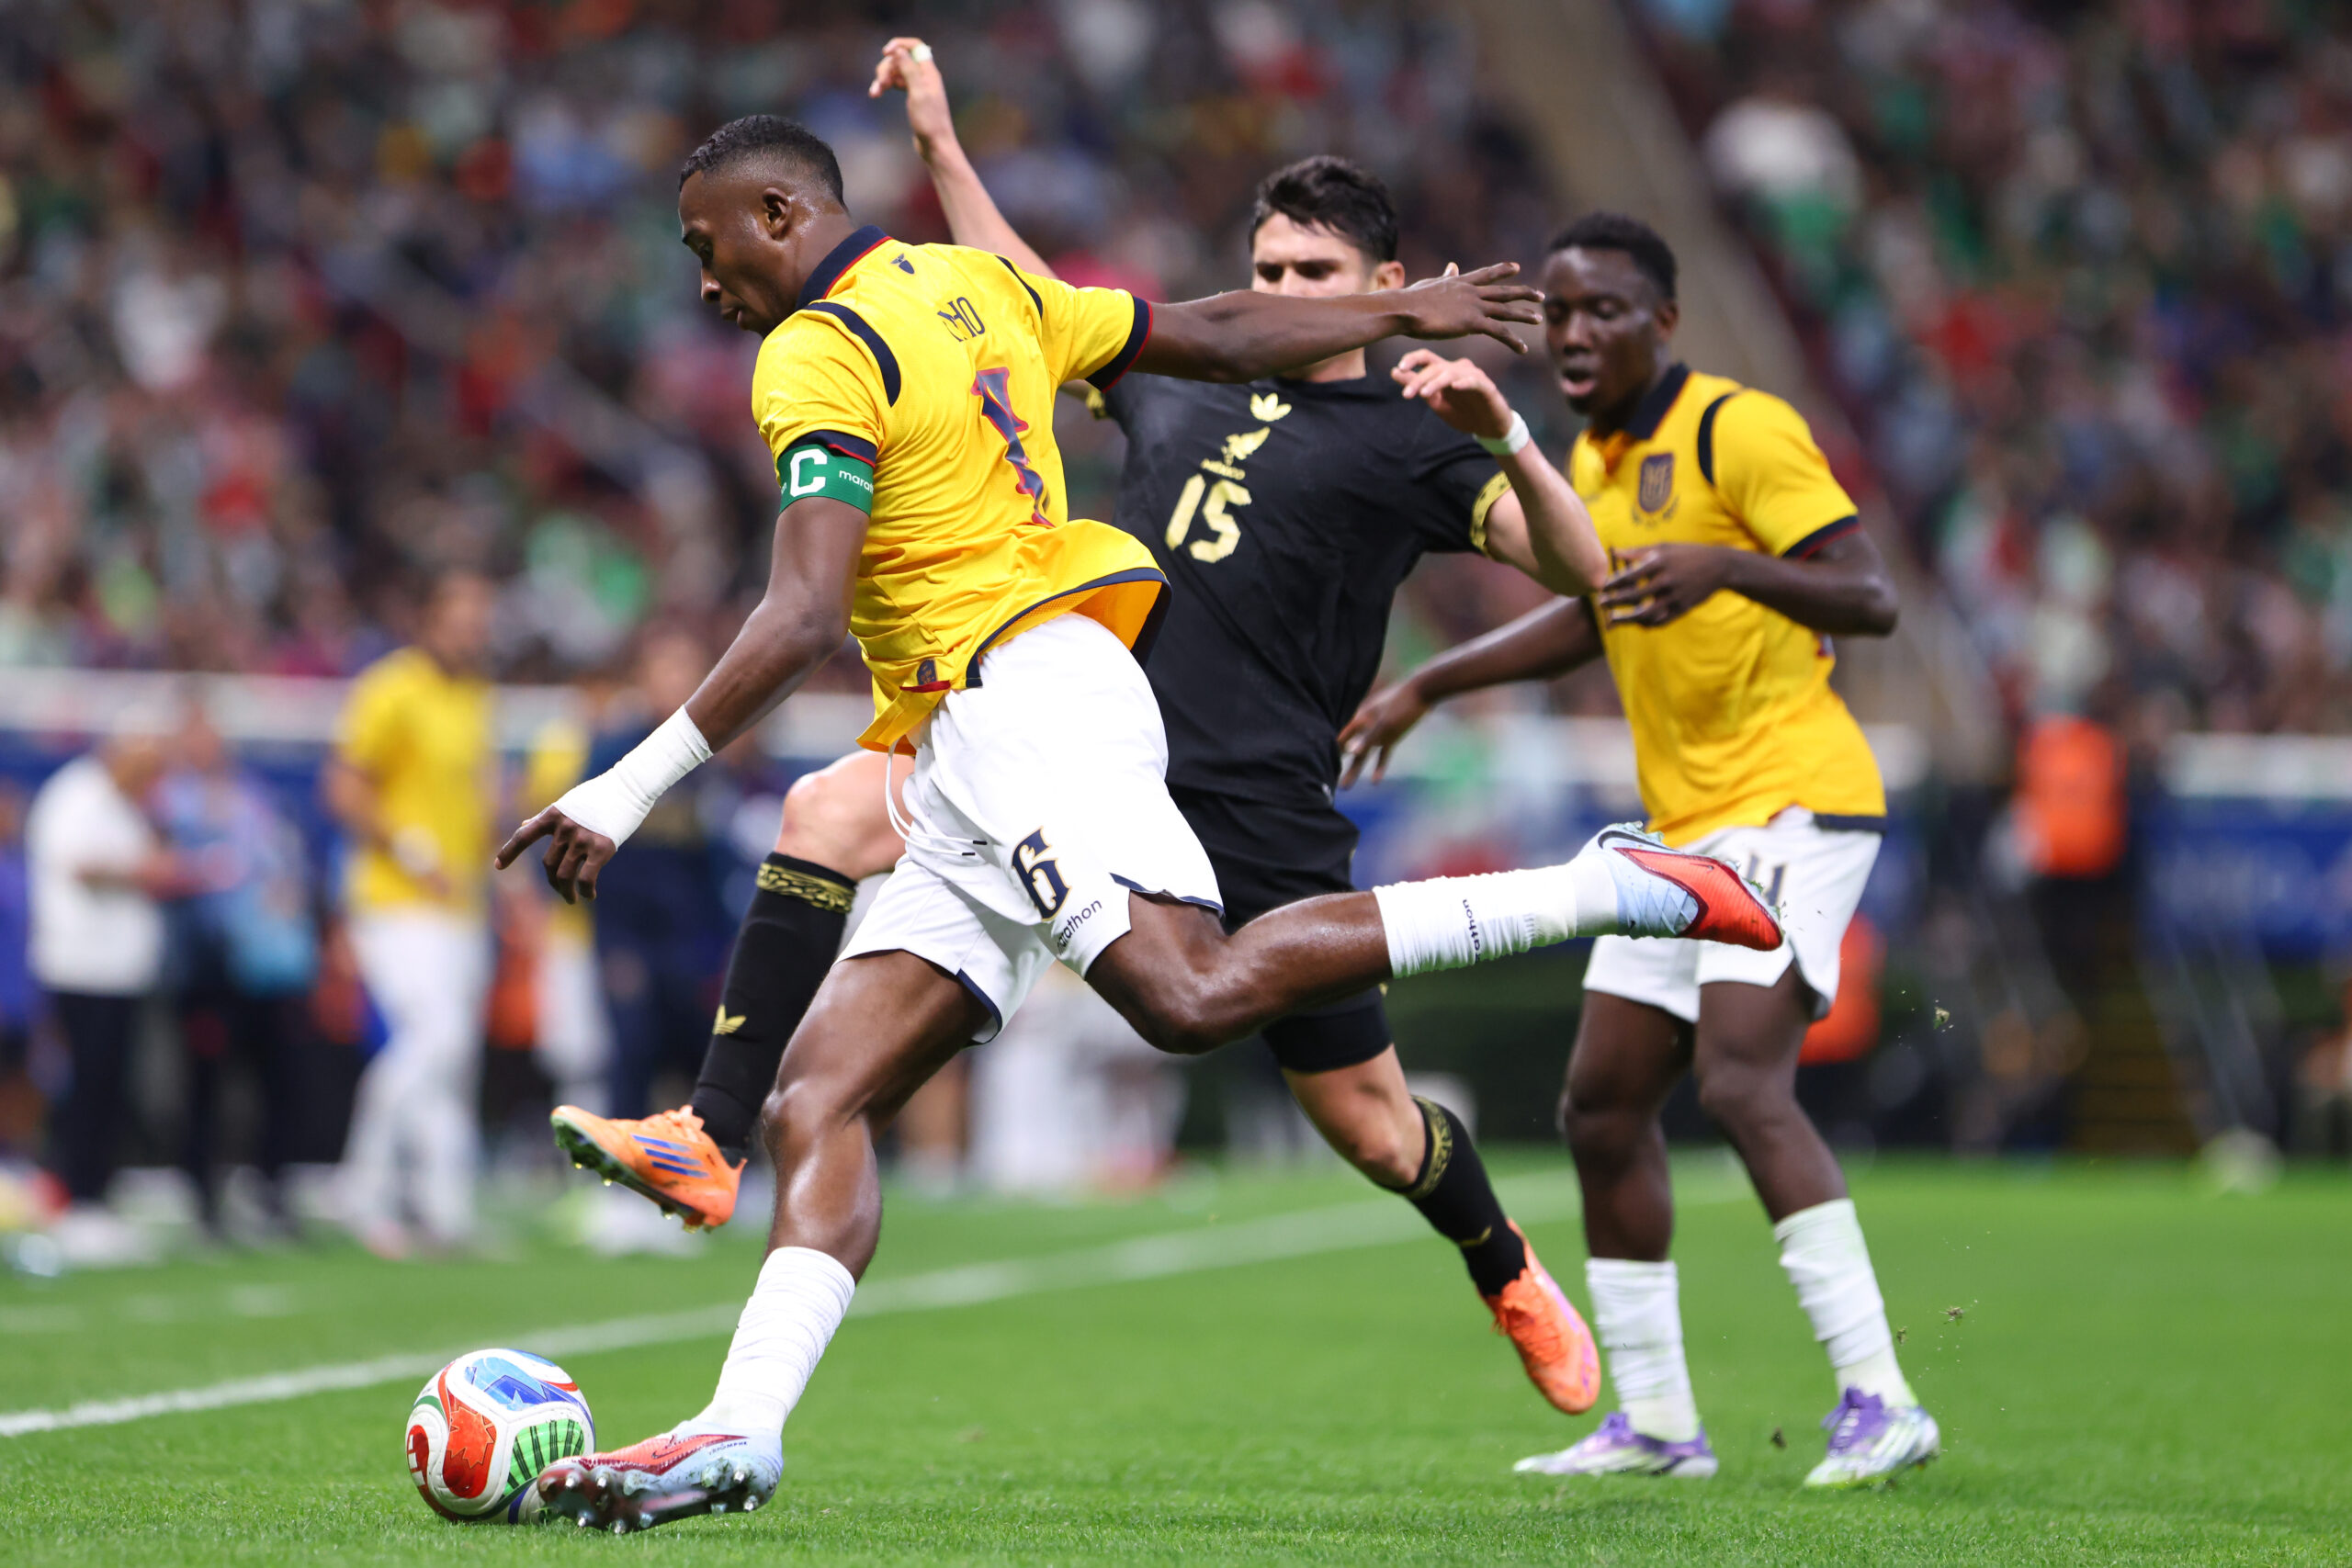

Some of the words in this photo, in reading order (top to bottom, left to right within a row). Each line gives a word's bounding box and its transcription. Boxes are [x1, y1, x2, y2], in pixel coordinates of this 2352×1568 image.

[790, 448, 828, 498] C
[1165, 473, 1252, 564] 15
[1012, 825, 1072, 922] 6
